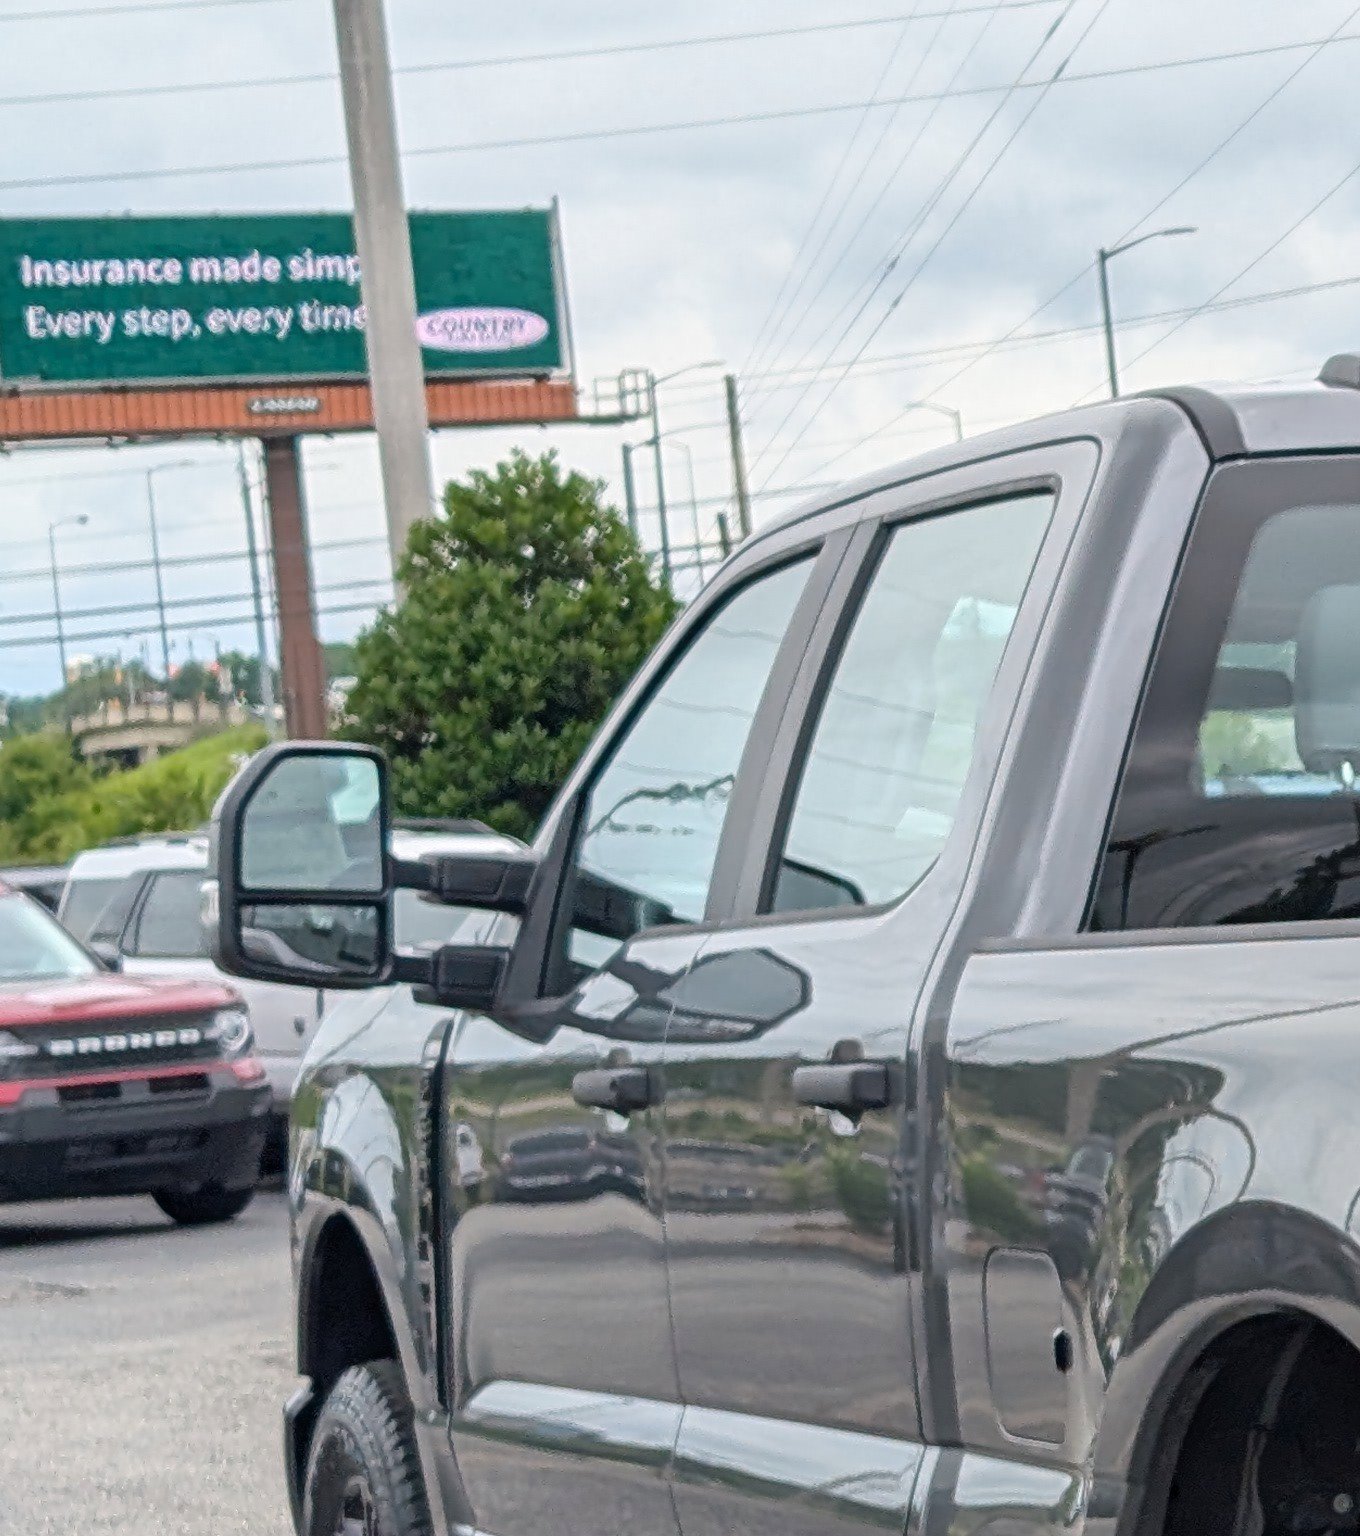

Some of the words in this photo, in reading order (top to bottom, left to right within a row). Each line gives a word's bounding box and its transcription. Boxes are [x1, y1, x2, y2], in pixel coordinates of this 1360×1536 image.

[22, 254, 184, 287] Insurance
[190, 249, 281, 285] made
[27, 305, 115, 343] Every
[122, 305, 200, 341] step,
[204, 306, 294, 339] every
[50, 1028, 200, 1056] BRONCO
